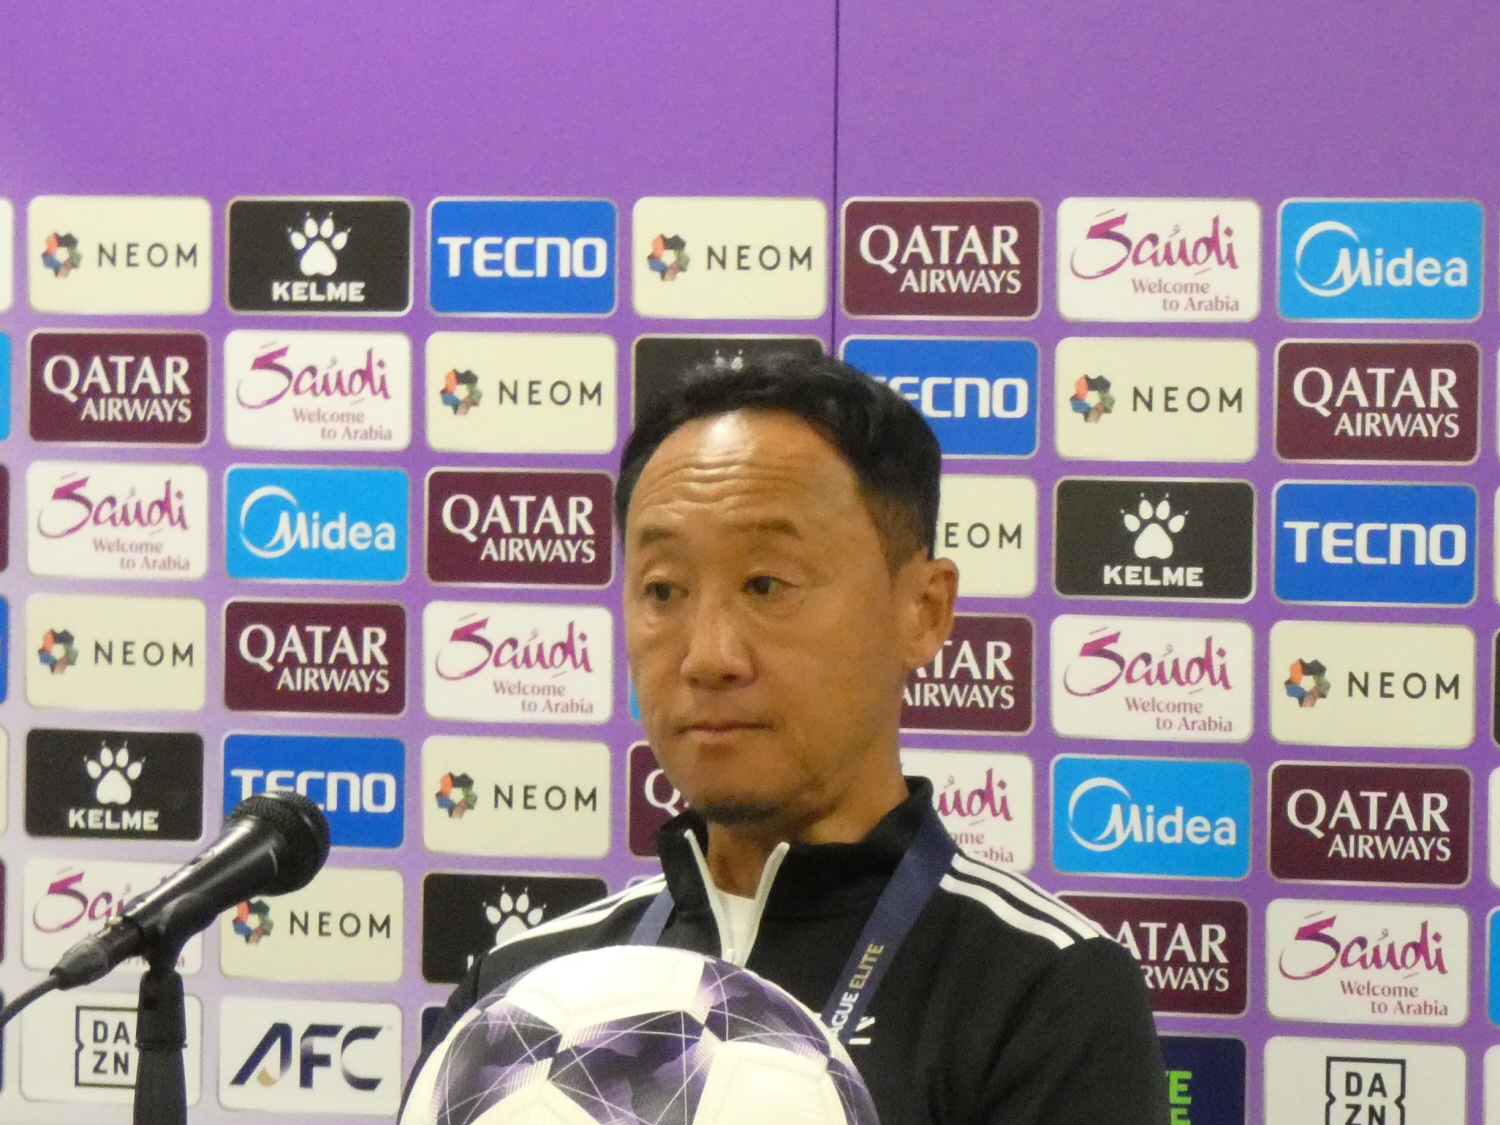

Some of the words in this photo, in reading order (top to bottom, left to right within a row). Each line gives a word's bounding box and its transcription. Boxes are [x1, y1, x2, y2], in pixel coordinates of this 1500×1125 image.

[98, 243, 197, 267] NEOM
[438, 237, 607, 277] TECNO
[707, 245, 811, 271] NEOM
[860, 225, 1020, 274] QATAR
[1071, 214, 1238, 279] Saudi
[1296, 221, 1467, 297] Midea
[272, 281, 365, 302] KELME
[900, 269, 1021, 294] AIRWAYS
[1132, 278, 1209, 294] Welcome
[1163, 298, 1180, 311] to
[1185, 296, 1239, 311] Arabia
[44, 355, 190, 402] QATAR
[238, 347, 389, 408] Saudi
[499, 381, 601, 406] NEOM
[1133, 387, 1242, 413] NEOM
[1293, 367, 1458, 417] QATAR
[81, 398, 191, 422] AIRWAYS
[293, 408, 364, 423] Welcome
[321, 427, 337, 439] to
[342, 426, 392, 440] Arabia
[1335, 413, 1459, 438] AIRWAYS
[40, 478, 187, 538] Saudi
[442, 494, 594, 542] QATAR
[240, 486, 395, 558] Midea
[93, 538, 163, 553] Welcome
[944, 522, 1022, 549] EOM
[1283, 521, 1466, 566] TECNO
[120, 557, 136, 569] to
[141, 555, 190, 570] Arabia
[481, 538, 595, 563] AIRWAYS
[1104, 565, 1203, 587] KELME
[95, 641, 193, 666] NEOM
[239, 624, 388, 672] QATAR
[436, 619, 592, 680] Saudi
[1064, 632, 1231, 696] Saudi
[277, 667, 389, 693] AIRWAYS
[493, 680, 565, 696] Welcome
[1348, 672, 1459, 699] NEOM
[521, 700, 538, 712] to
[542, 699, 593, 714] Arabia
[1125, 697, 1202, 714] Welcome
[1156, 717, 1173, 730] to
[1178, 716, 1232, 732] Arabia
[494, 785, 596, 811] NEOM
[68, 809, 158, 831] KELME
[1069, 777, 1236, 852] Midea
[1287, 789, 1450, 838] QATAR
[1328, 834, 1451, 861] AIRWAYS
[290, 912, 390, 938] NEOM
[1115, 921, 1229, 964] ATAR
[1279, 916, 1447, 980] Saudi
[849, 943, 884, 989] ELITE
[1340, 981, 1417, 997] Welcome
[1371, 1001, 1388, 1013] to
[1392, 1001, 1448, 1016] Arabia
[231, 1023, 381, 1091] AFC
